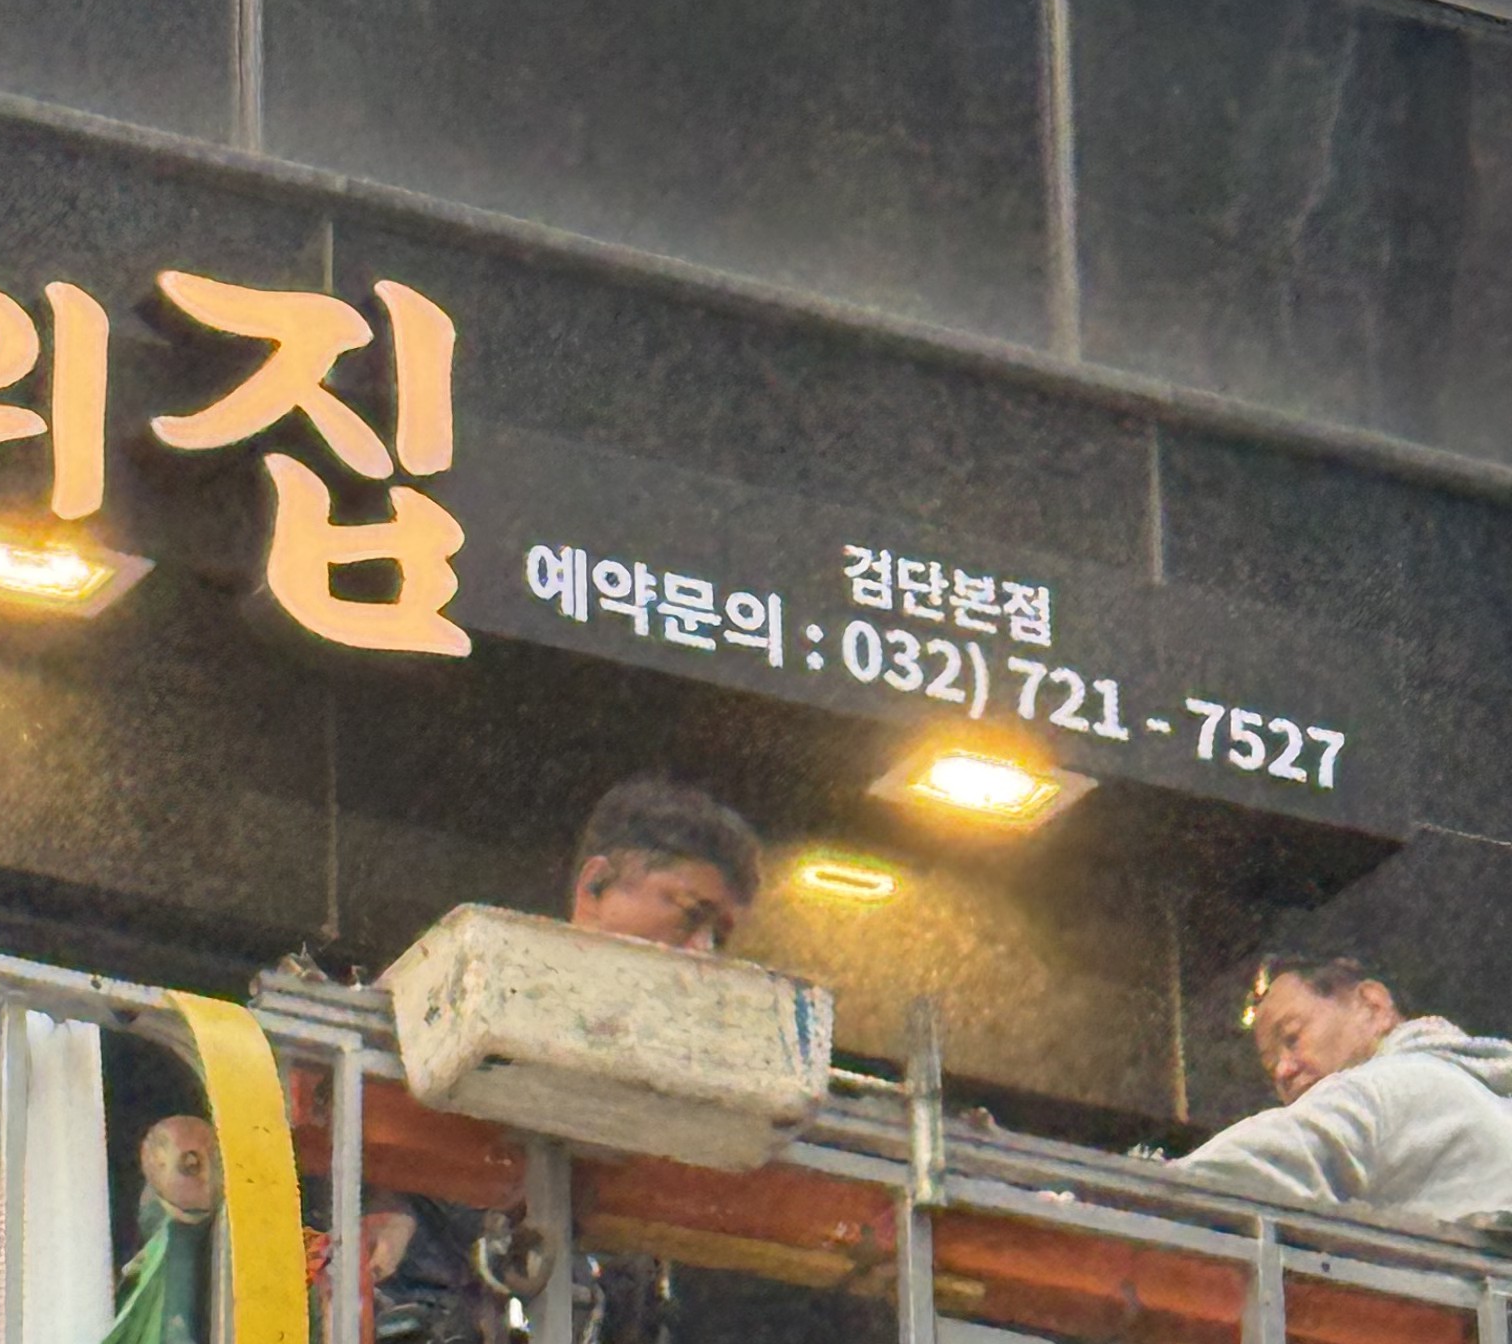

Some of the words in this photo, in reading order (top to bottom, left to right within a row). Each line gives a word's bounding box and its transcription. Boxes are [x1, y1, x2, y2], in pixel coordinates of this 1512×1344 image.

[526, 544, 784, 669] 예약문의
[1185, 697, 1345, 789] 7527
[842, 544, 1052, 647] 검단본점
